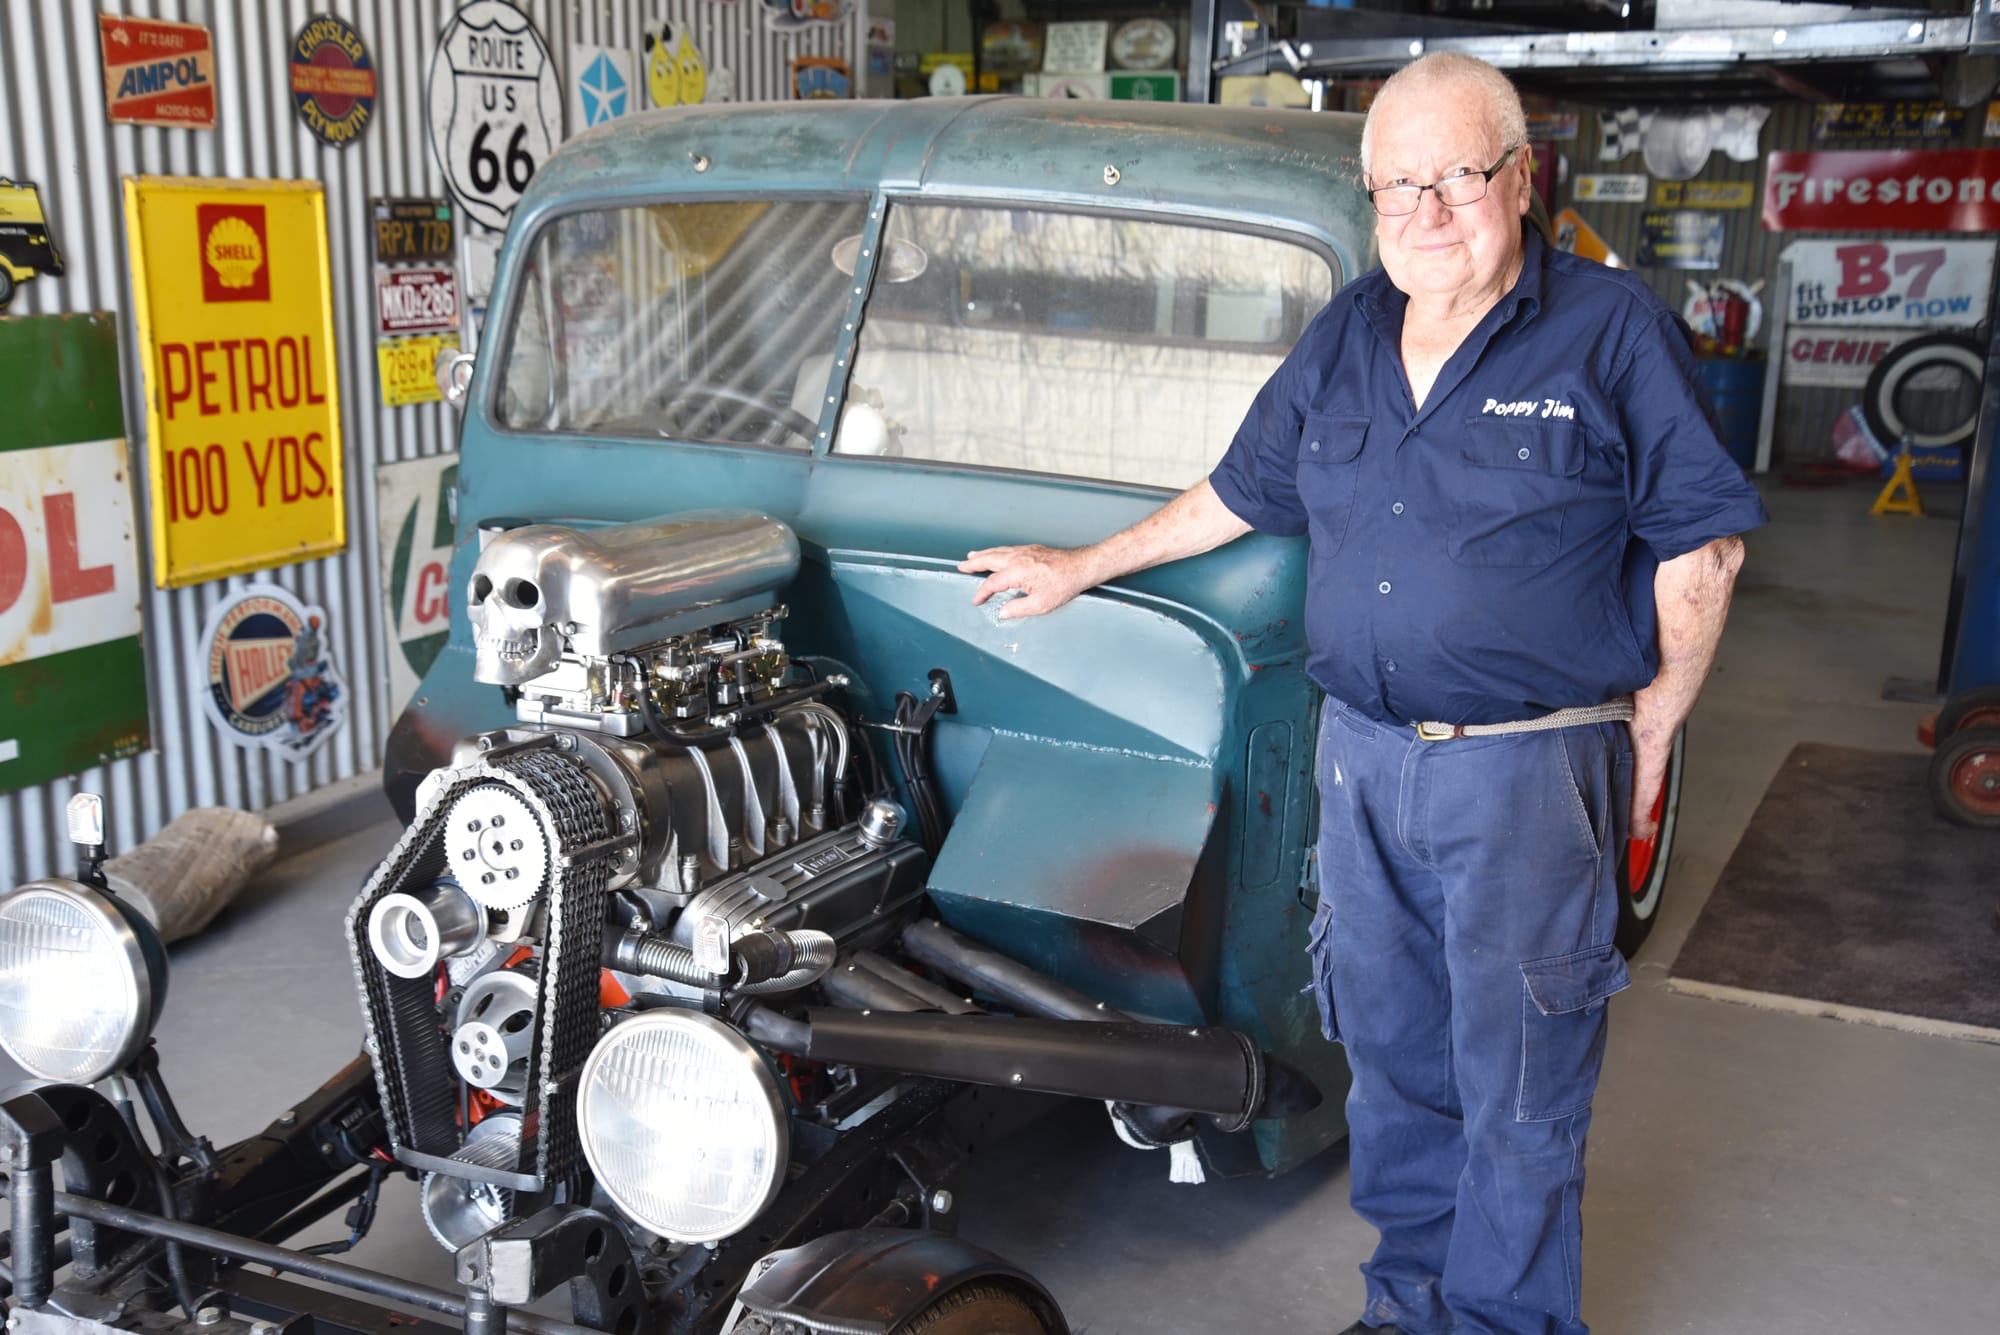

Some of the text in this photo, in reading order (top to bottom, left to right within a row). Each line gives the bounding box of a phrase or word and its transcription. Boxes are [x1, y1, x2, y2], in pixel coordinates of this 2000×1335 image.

[297, 20, 364, 62] CHRYSLER
[468, 35, 525, 71] ROUTE
[116, 56, 207, 99] AMPOL
[156, 103, 190, 117] MOTOR
[302, 98, 369, 141] PLYMOUTH
[469, 122, 535, 195] 66
[214, 244, 256, 261] SHELL
[378, 221, 417, 257] RPX
[1836, 242, 1946, 301] B7
[1796, 280, 1825, 302] fit
[1796, 294, 1973, 320] DUNLOP now
[1792, 338, 1890, 365] GENIE
[161, 336, 326, 420] PETROL
[1482, 398, 1575, 420] Poppy Jim
[166, 432, 334, 523] 100 YDS.
